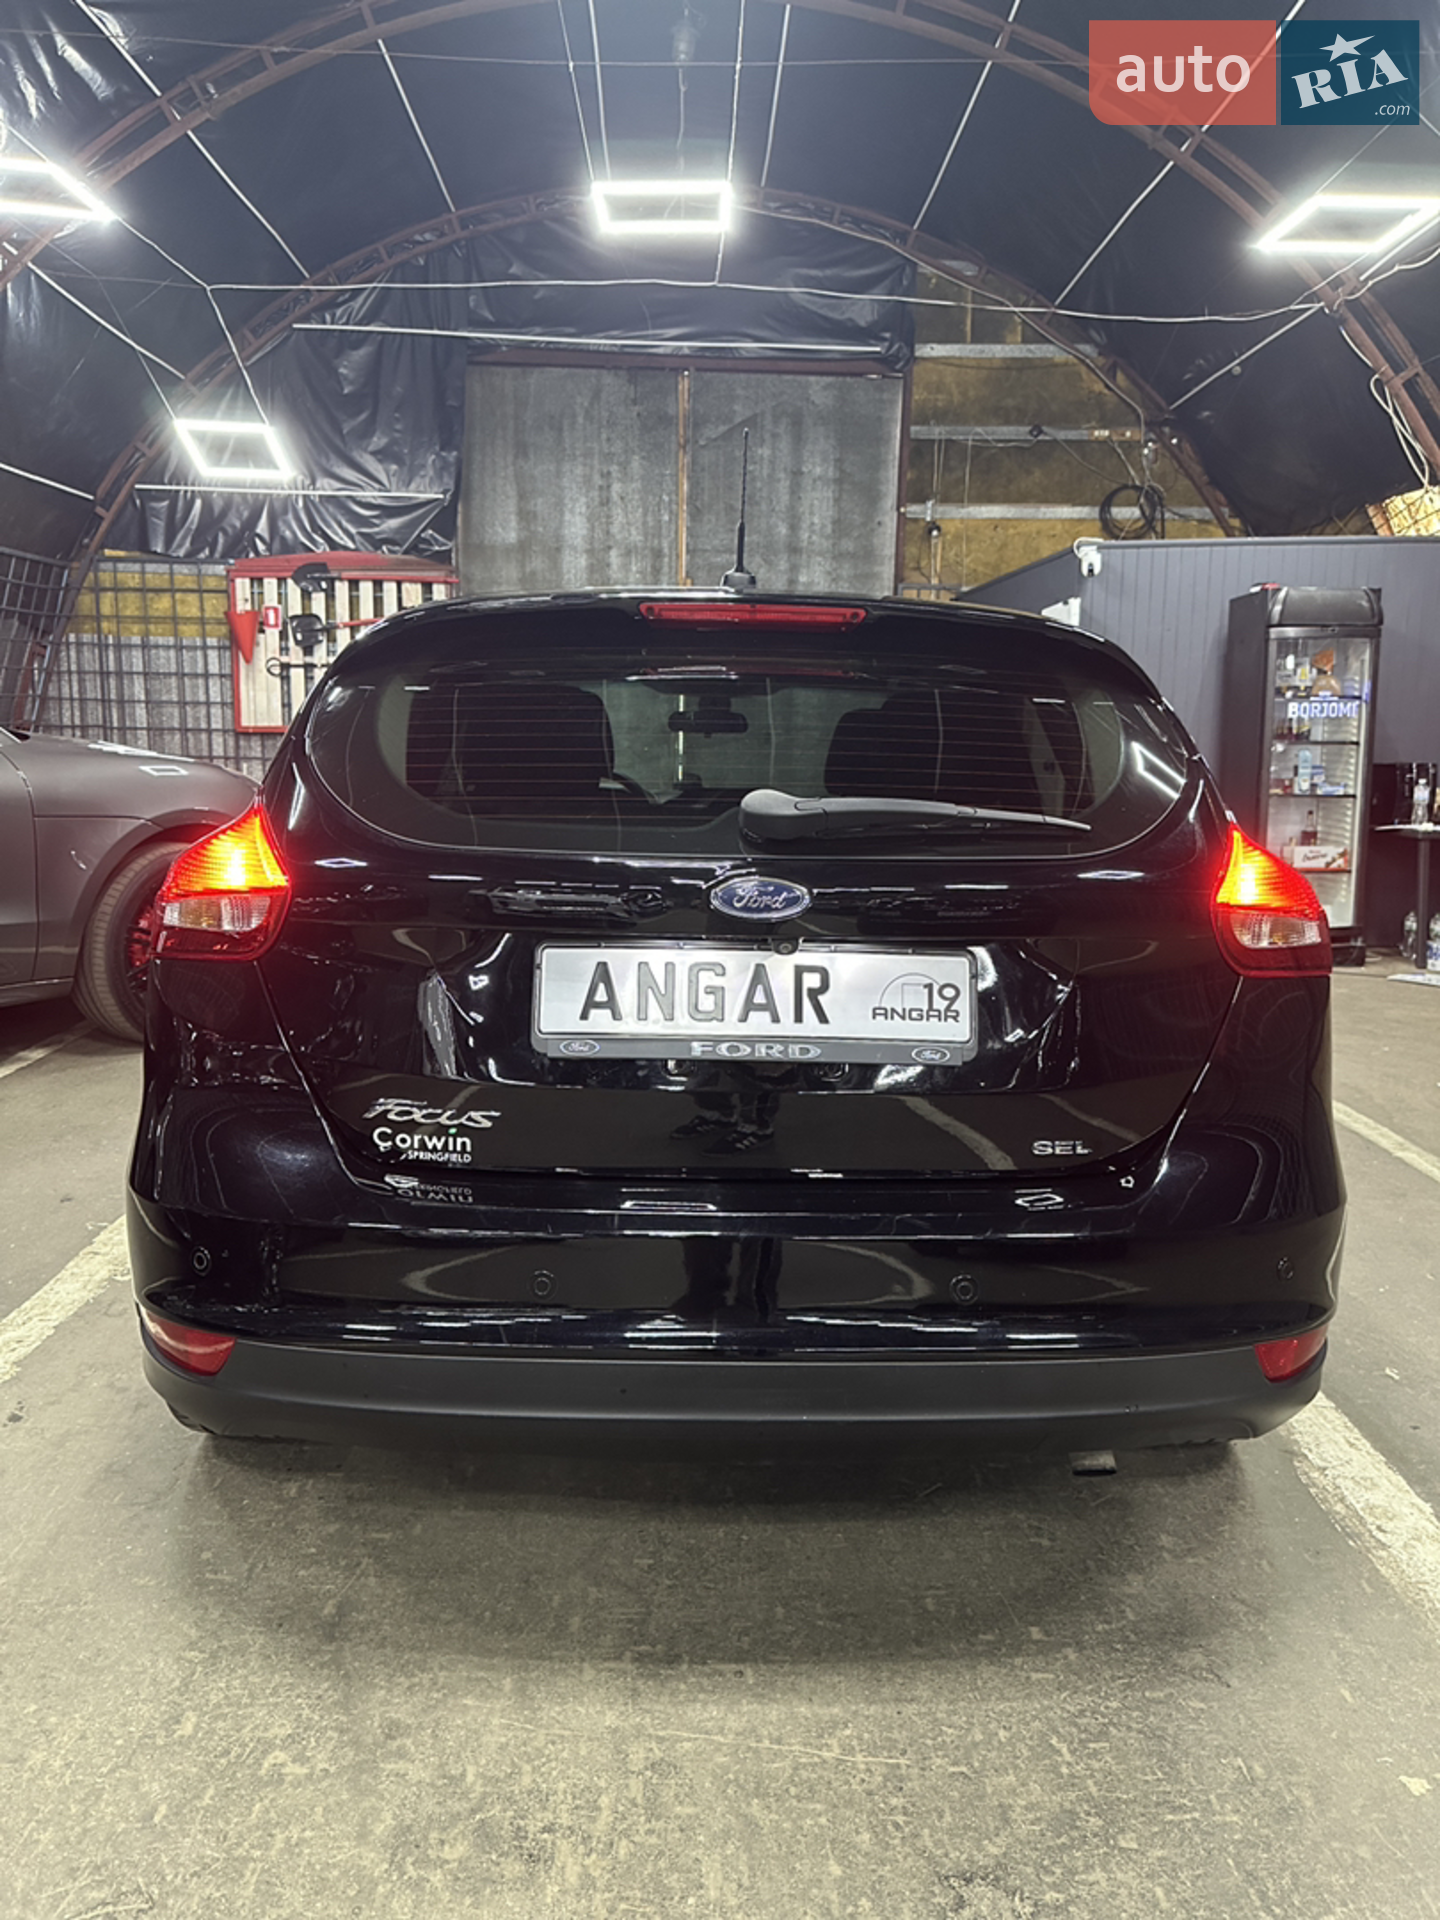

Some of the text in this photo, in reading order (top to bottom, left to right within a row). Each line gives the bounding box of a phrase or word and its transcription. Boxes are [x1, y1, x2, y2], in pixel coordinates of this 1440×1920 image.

[731, 881, 801, 909] Ford
[579, 961, 831, 1024] ANGAR
[923, 982, 961, 1010] 19
[872, 1006, 960, 1023] ANGAR
[690, 1041, 822, 1060] FORD
[362, 1098, 502, 1128] Focus
[372, 1126, 472, 1152] Corwin
[1032, 1140, 1093, 1155] SEL
[407, 1150, 472, 1163] SPRINGFIELD
